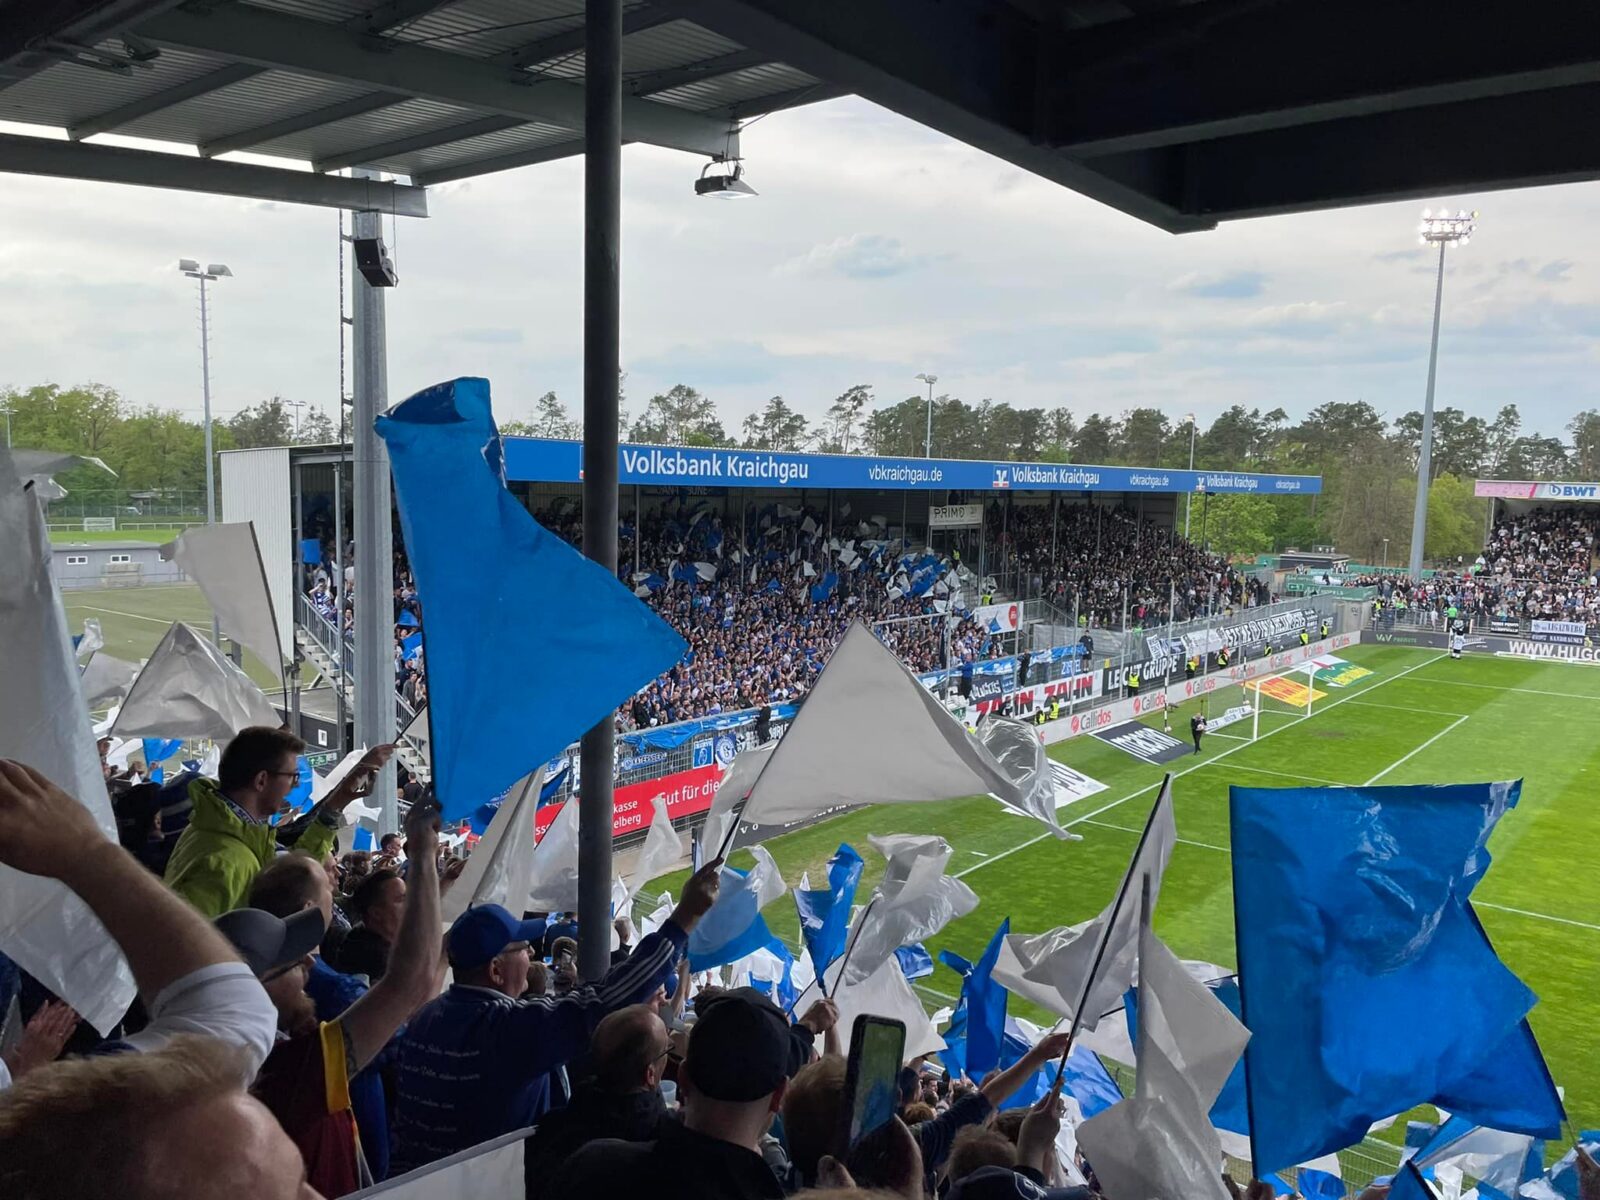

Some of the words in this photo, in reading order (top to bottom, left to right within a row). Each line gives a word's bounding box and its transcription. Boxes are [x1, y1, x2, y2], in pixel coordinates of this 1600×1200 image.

[622, 449, 722, 476] Volksbank
[727, 455, 809, 484] Kraichgau
[868, 464, 943, 485] vbkraichgau.de
[1012, 466, 1058, 483] Volksbank
[1060, 468, 1100, 488] Kraichgau
[1207, 474, 1233, 488] Volksbank
[1234, 476, 1258, 491] Kraichgau
[1563, 486, 1597, 497] BWT
[934, 506, 965, 518] PRIMO
[1143, 656, 1178, 681] GRUPPE
[1141, 692, 1166, 713] Callido
[1080, 708, 1112, 731] Callidos
[682, 784, 700, 802] für
[701, 779, 720, 797] die
